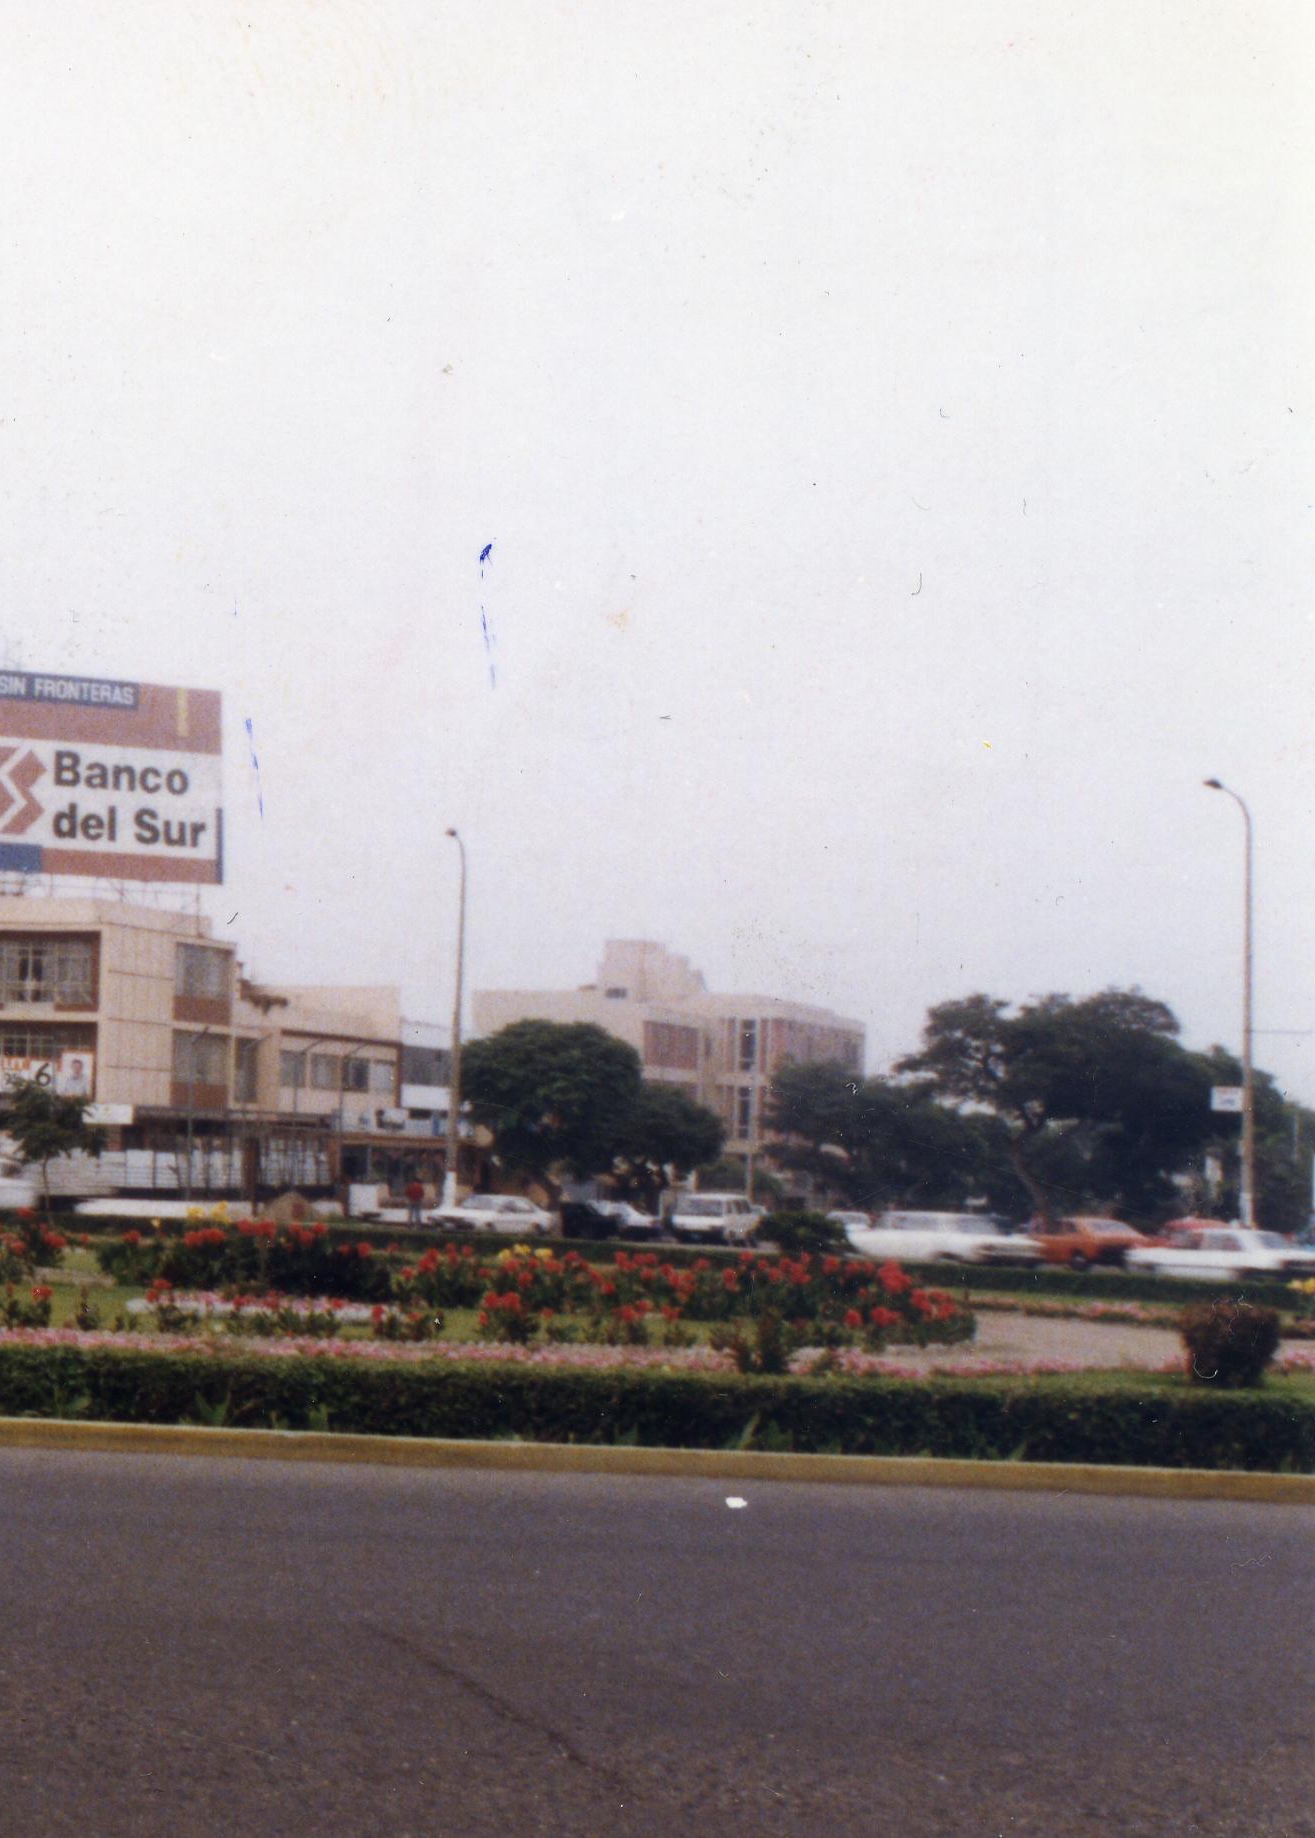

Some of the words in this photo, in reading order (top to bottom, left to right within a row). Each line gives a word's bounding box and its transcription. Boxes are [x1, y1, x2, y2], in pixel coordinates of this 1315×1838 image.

[34, 678, 134, 706] FRONTERAS
[54, 750, 189, 795] Banco
[52, 802, 117, 842] del
[134, 808, 206, 848] Sur
[35, 1062, 51, 1087] 6
